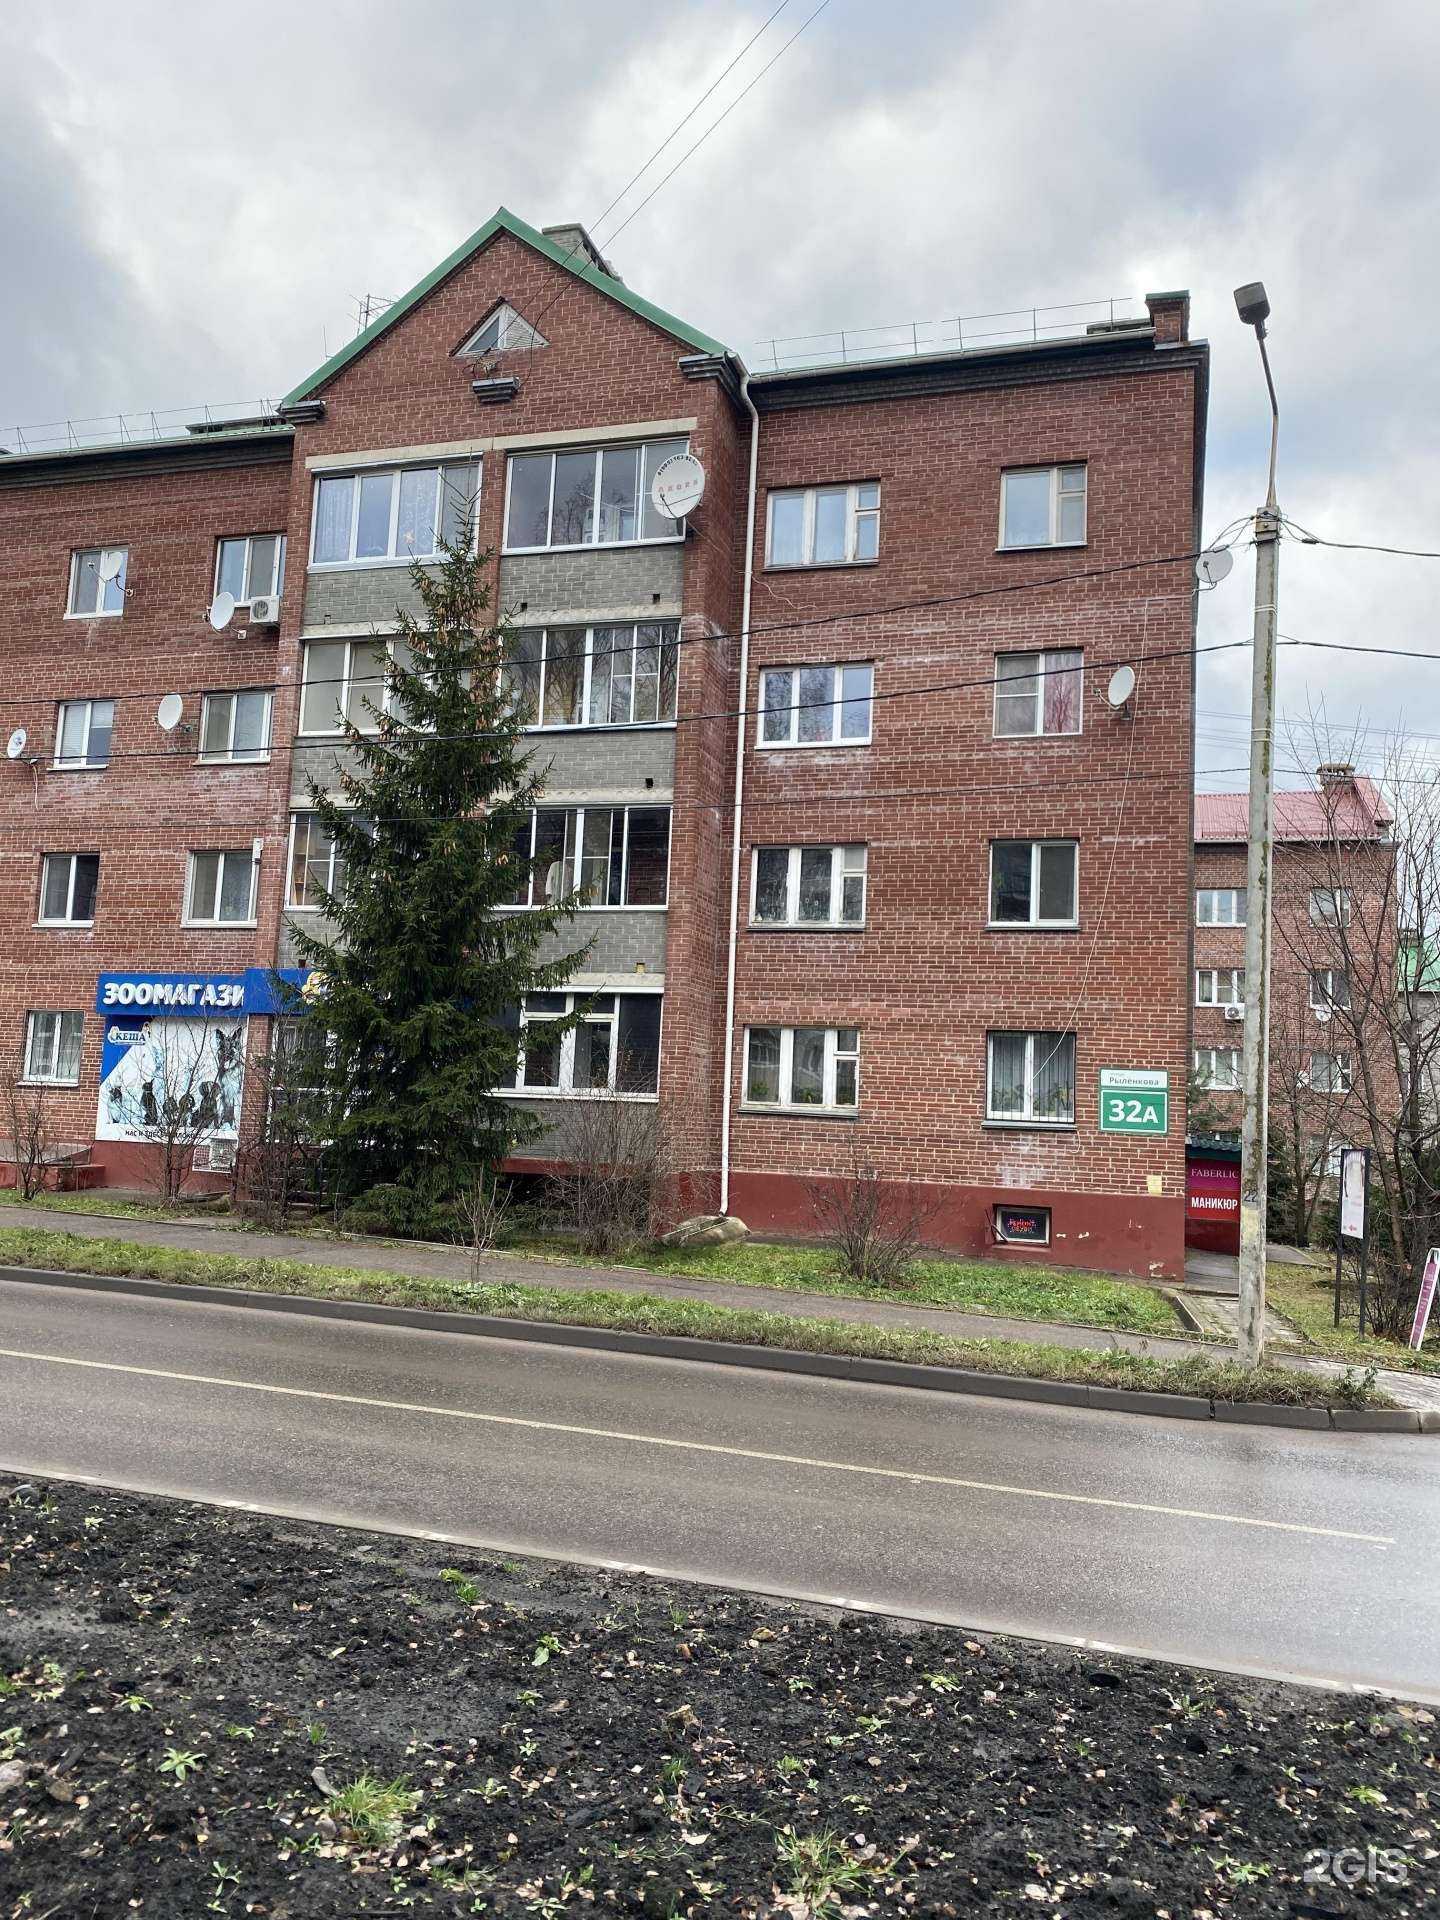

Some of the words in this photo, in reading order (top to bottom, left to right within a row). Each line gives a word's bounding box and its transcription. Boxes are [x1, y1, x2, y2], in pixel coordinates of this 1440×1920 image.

[116, 1032, 146, 1041] КЕША
[1109, 1076, 1159, 1086] Рыленкова
[1191, 1168, 1238, 1179] FABERLIC
[1191, 1197, 1238, 1210] МАНИКЮР
